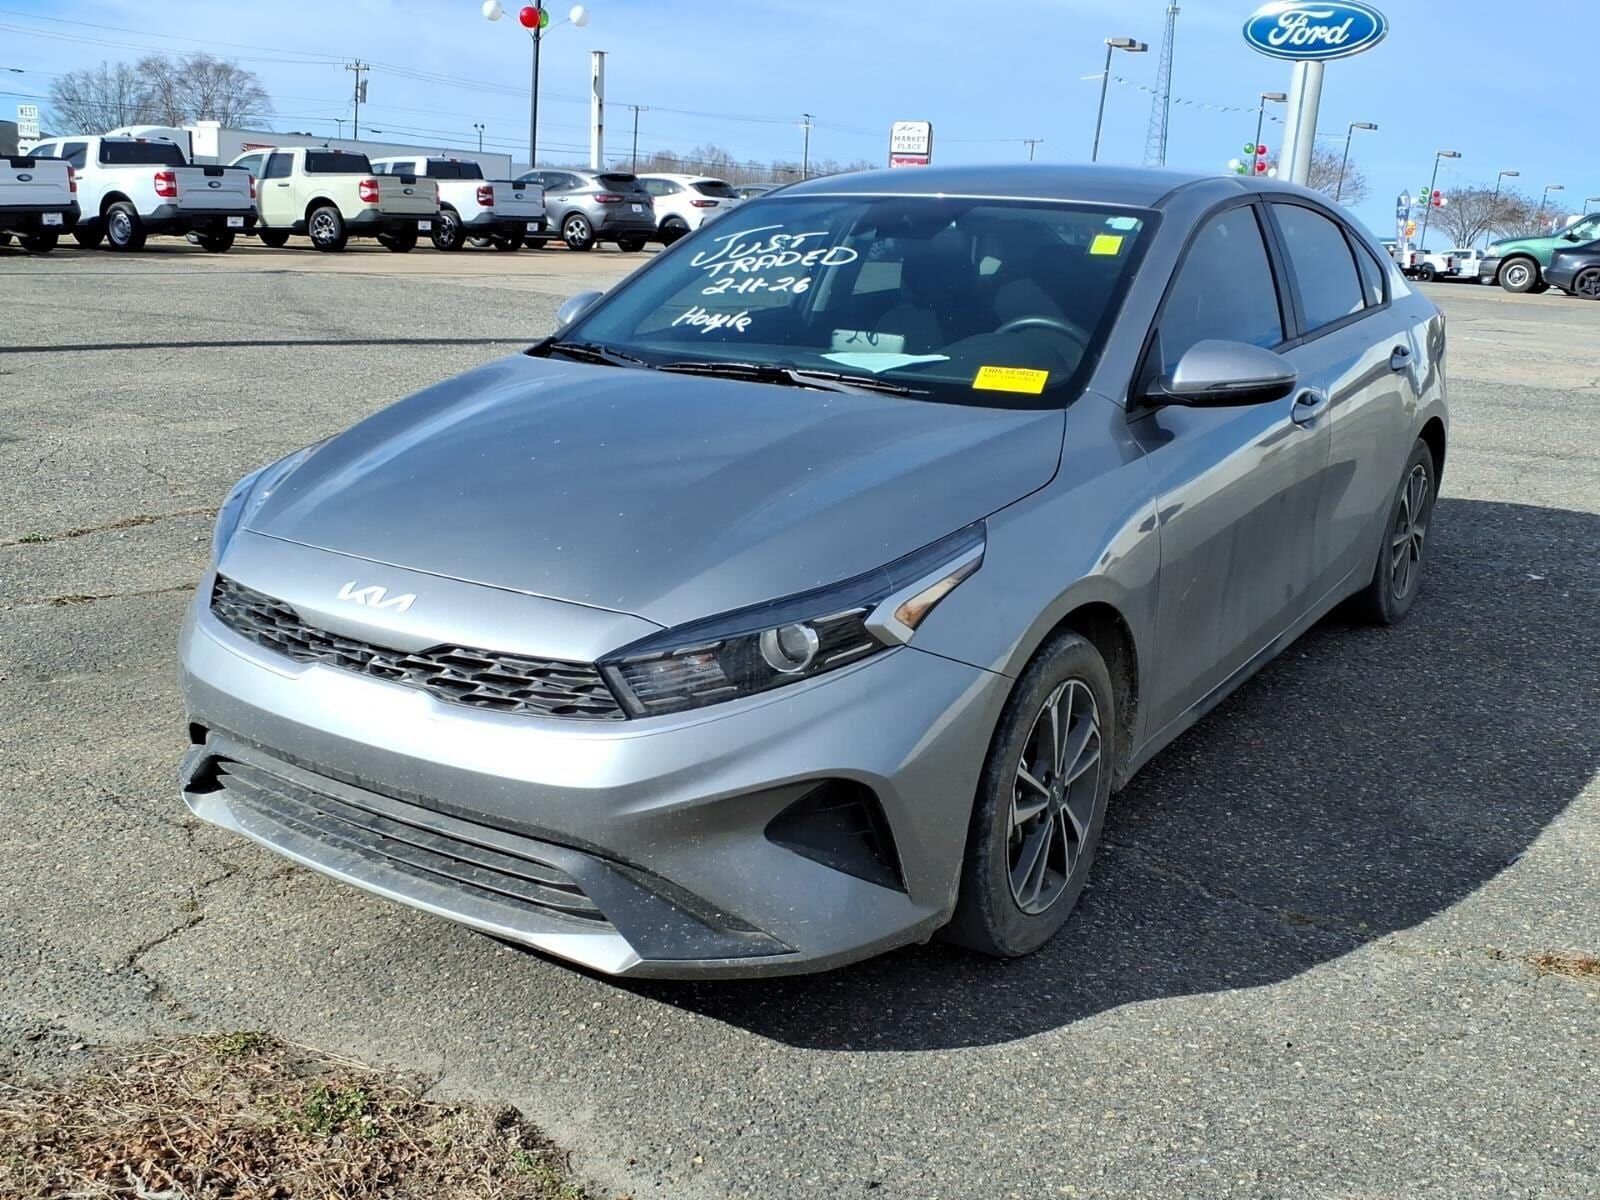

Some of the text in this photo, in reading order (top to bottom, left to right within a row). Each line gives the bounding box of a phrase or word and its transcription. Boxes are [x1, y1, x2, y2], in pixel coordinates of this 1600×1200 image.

[1268, 10, 1354, 45] Ford
[20, 107, 36, 117] WEST
[691, 224, 829, 266] JUST
[703, 246, 858, 277] TRADED
[702, 276, 812, 295] 2-11-26
